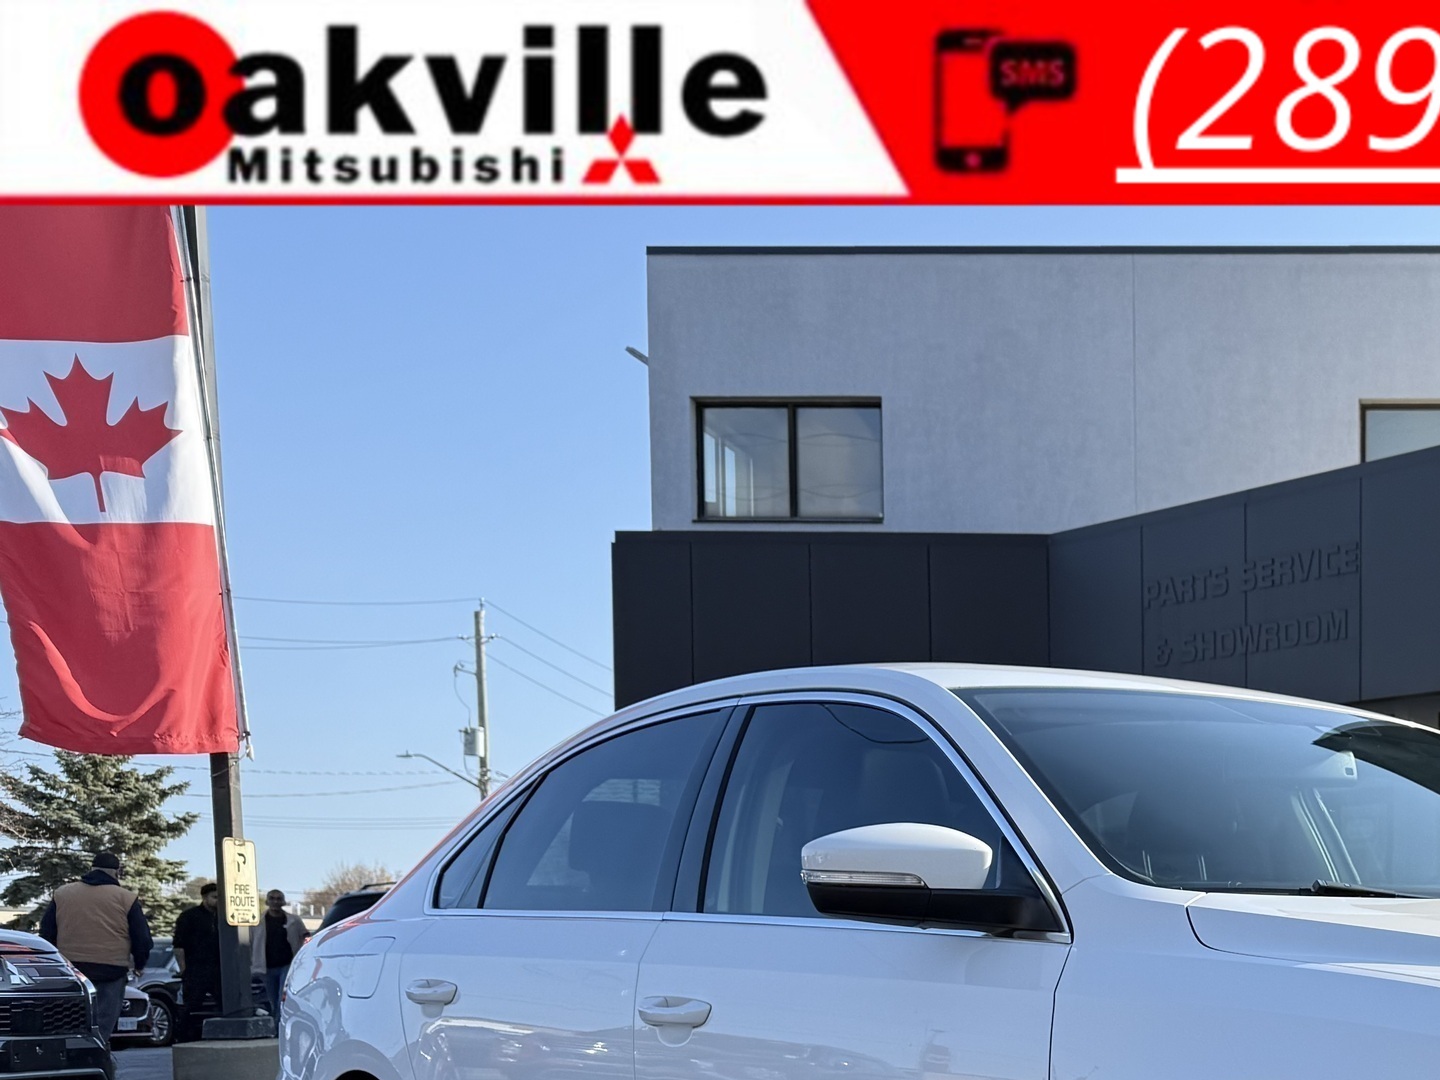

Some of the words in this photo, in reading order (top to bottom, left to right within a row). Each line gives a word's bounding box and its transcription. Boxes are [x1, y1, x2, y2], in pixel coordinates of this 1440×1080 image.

[1144, 565, 1229, 611] PARTS
[1241, 541, 1360, 594] SERVICE
[1154, 637, 1173, 668] &
[1181, 608, 1349, 665] SHOWROOM
[230, 895, 255, 907] ROUTE
[234, 883, 250, 895] FIRE
